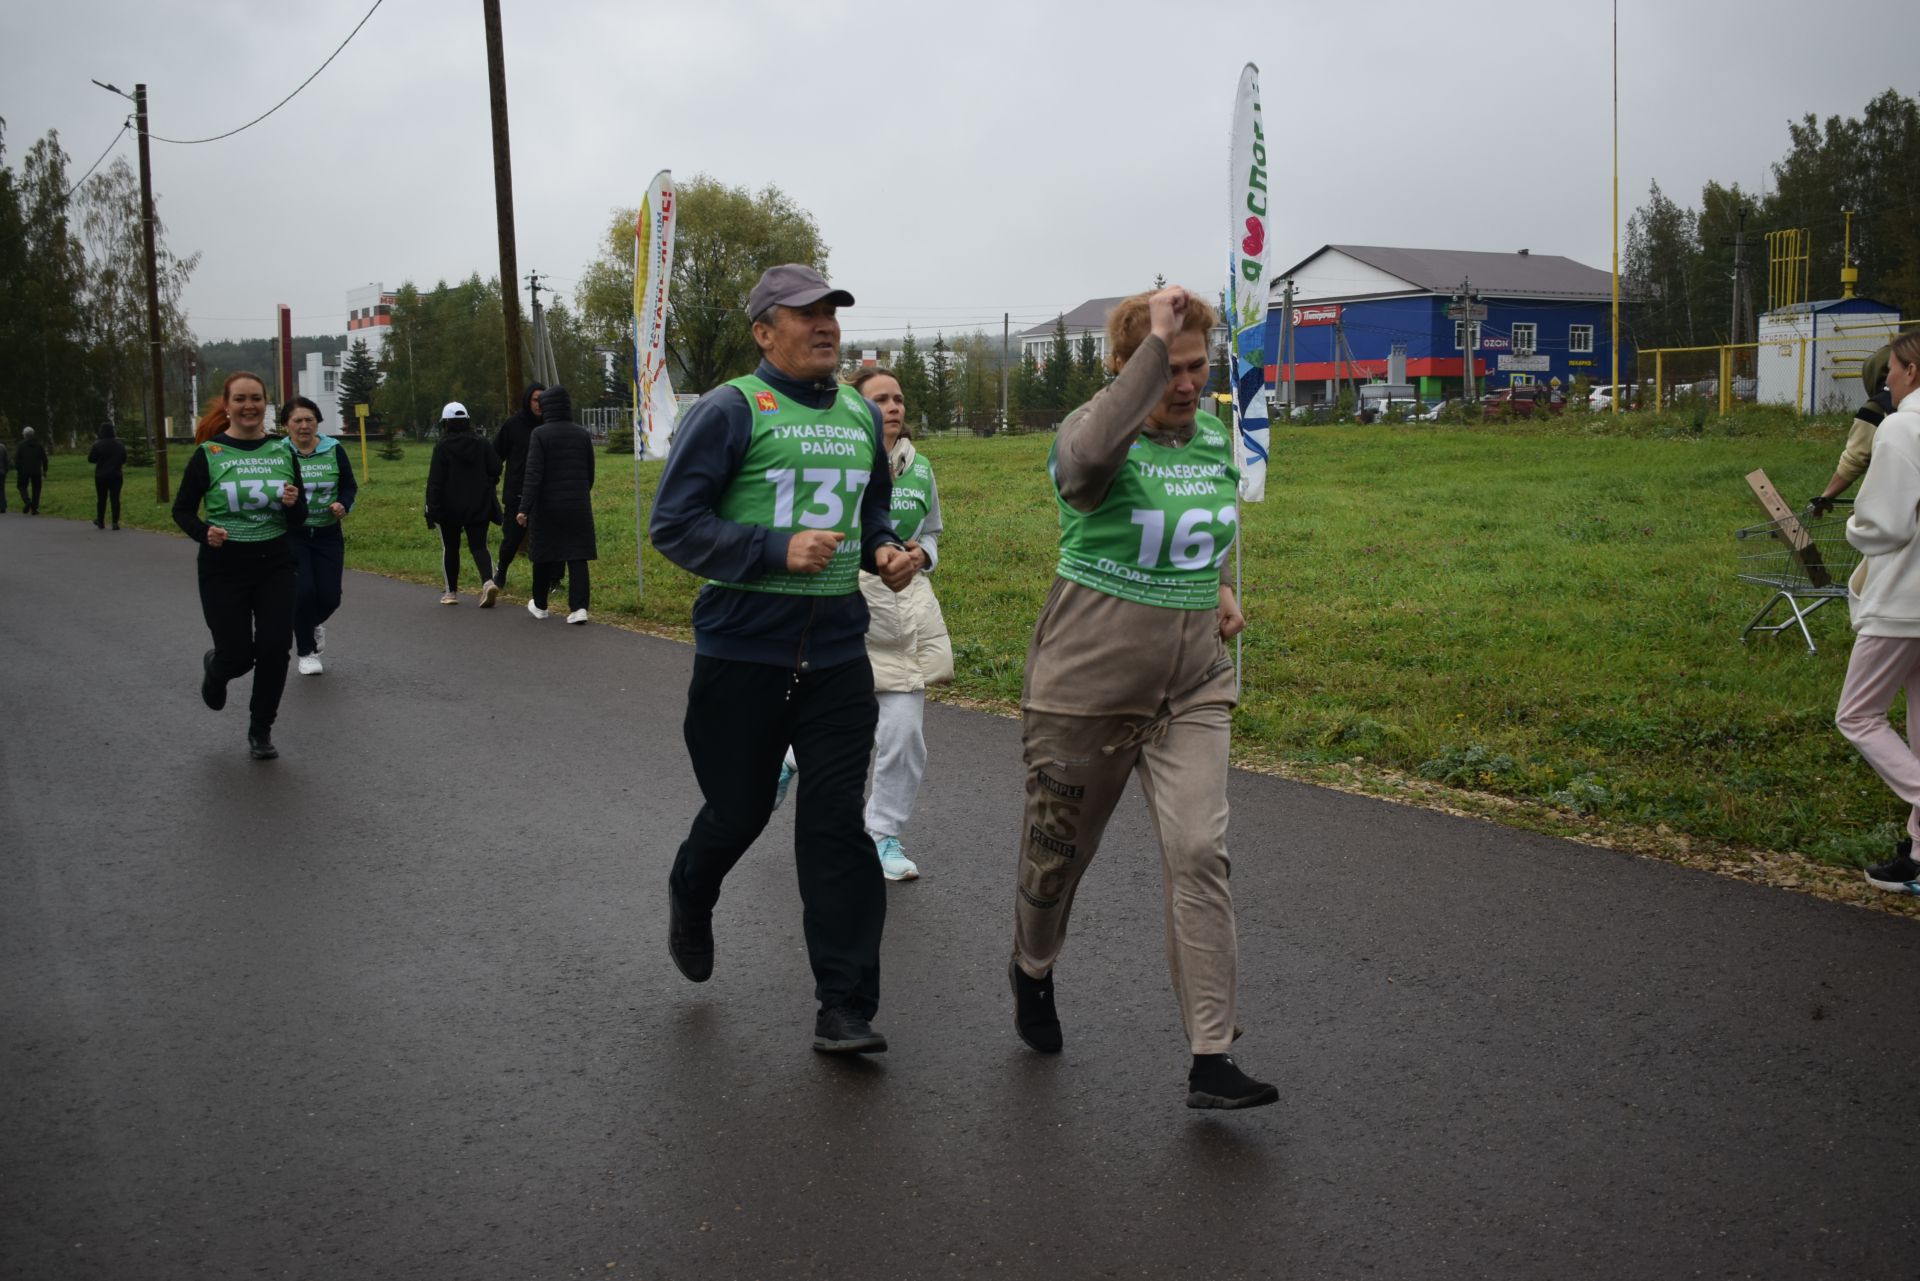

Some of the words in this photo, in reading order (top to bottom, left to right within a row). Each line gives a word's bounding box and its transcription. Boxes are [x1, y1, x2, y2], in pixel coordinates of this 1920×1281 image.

[772, 424, 868, 442] ТУКАЕВСКИЙ
[801, 440, 856, 456] РАЙОН
[219, 457, 284, 470] ТУКАЕВСКИЙ
[236, 465, 272, 475] РАЙОН
[1139, 461, 1227, 478] ТУКАЕВСКИЙ
[891, 487, 925, 500] ЕВСКИЙ
[1164, 481, 1217, 496] РАЙОН
[765, 468, 871, 528] 137
[890, 499, 917, 510] ЙОН
